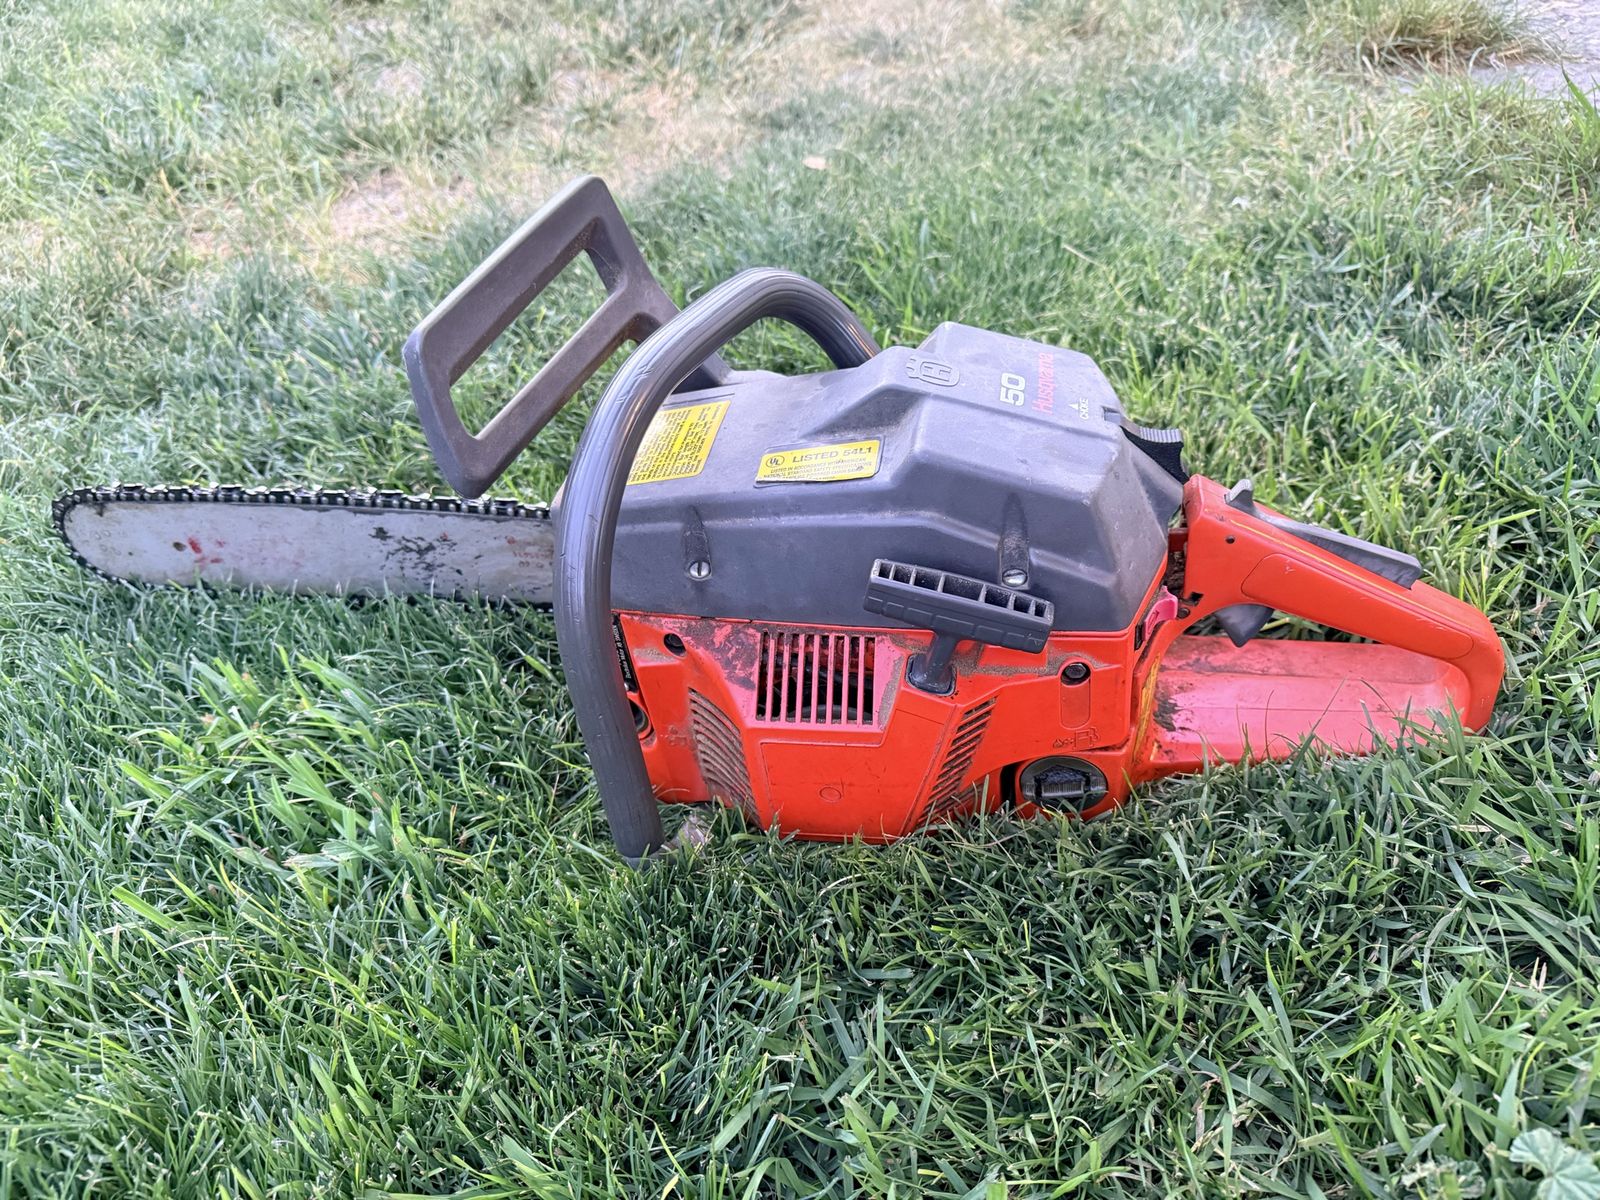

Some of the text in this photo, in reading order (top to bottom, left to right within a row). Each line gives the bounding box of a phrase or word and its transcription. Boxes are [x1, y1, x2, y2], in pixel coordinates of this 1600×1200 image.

[1000, 372, 1026, 407] 50
[1032, 352, 1055, 416] Husqvarna
[1079, 397, 1088, 420] CHOKE
[792, 446, 873, 464] LISTED 54L1
